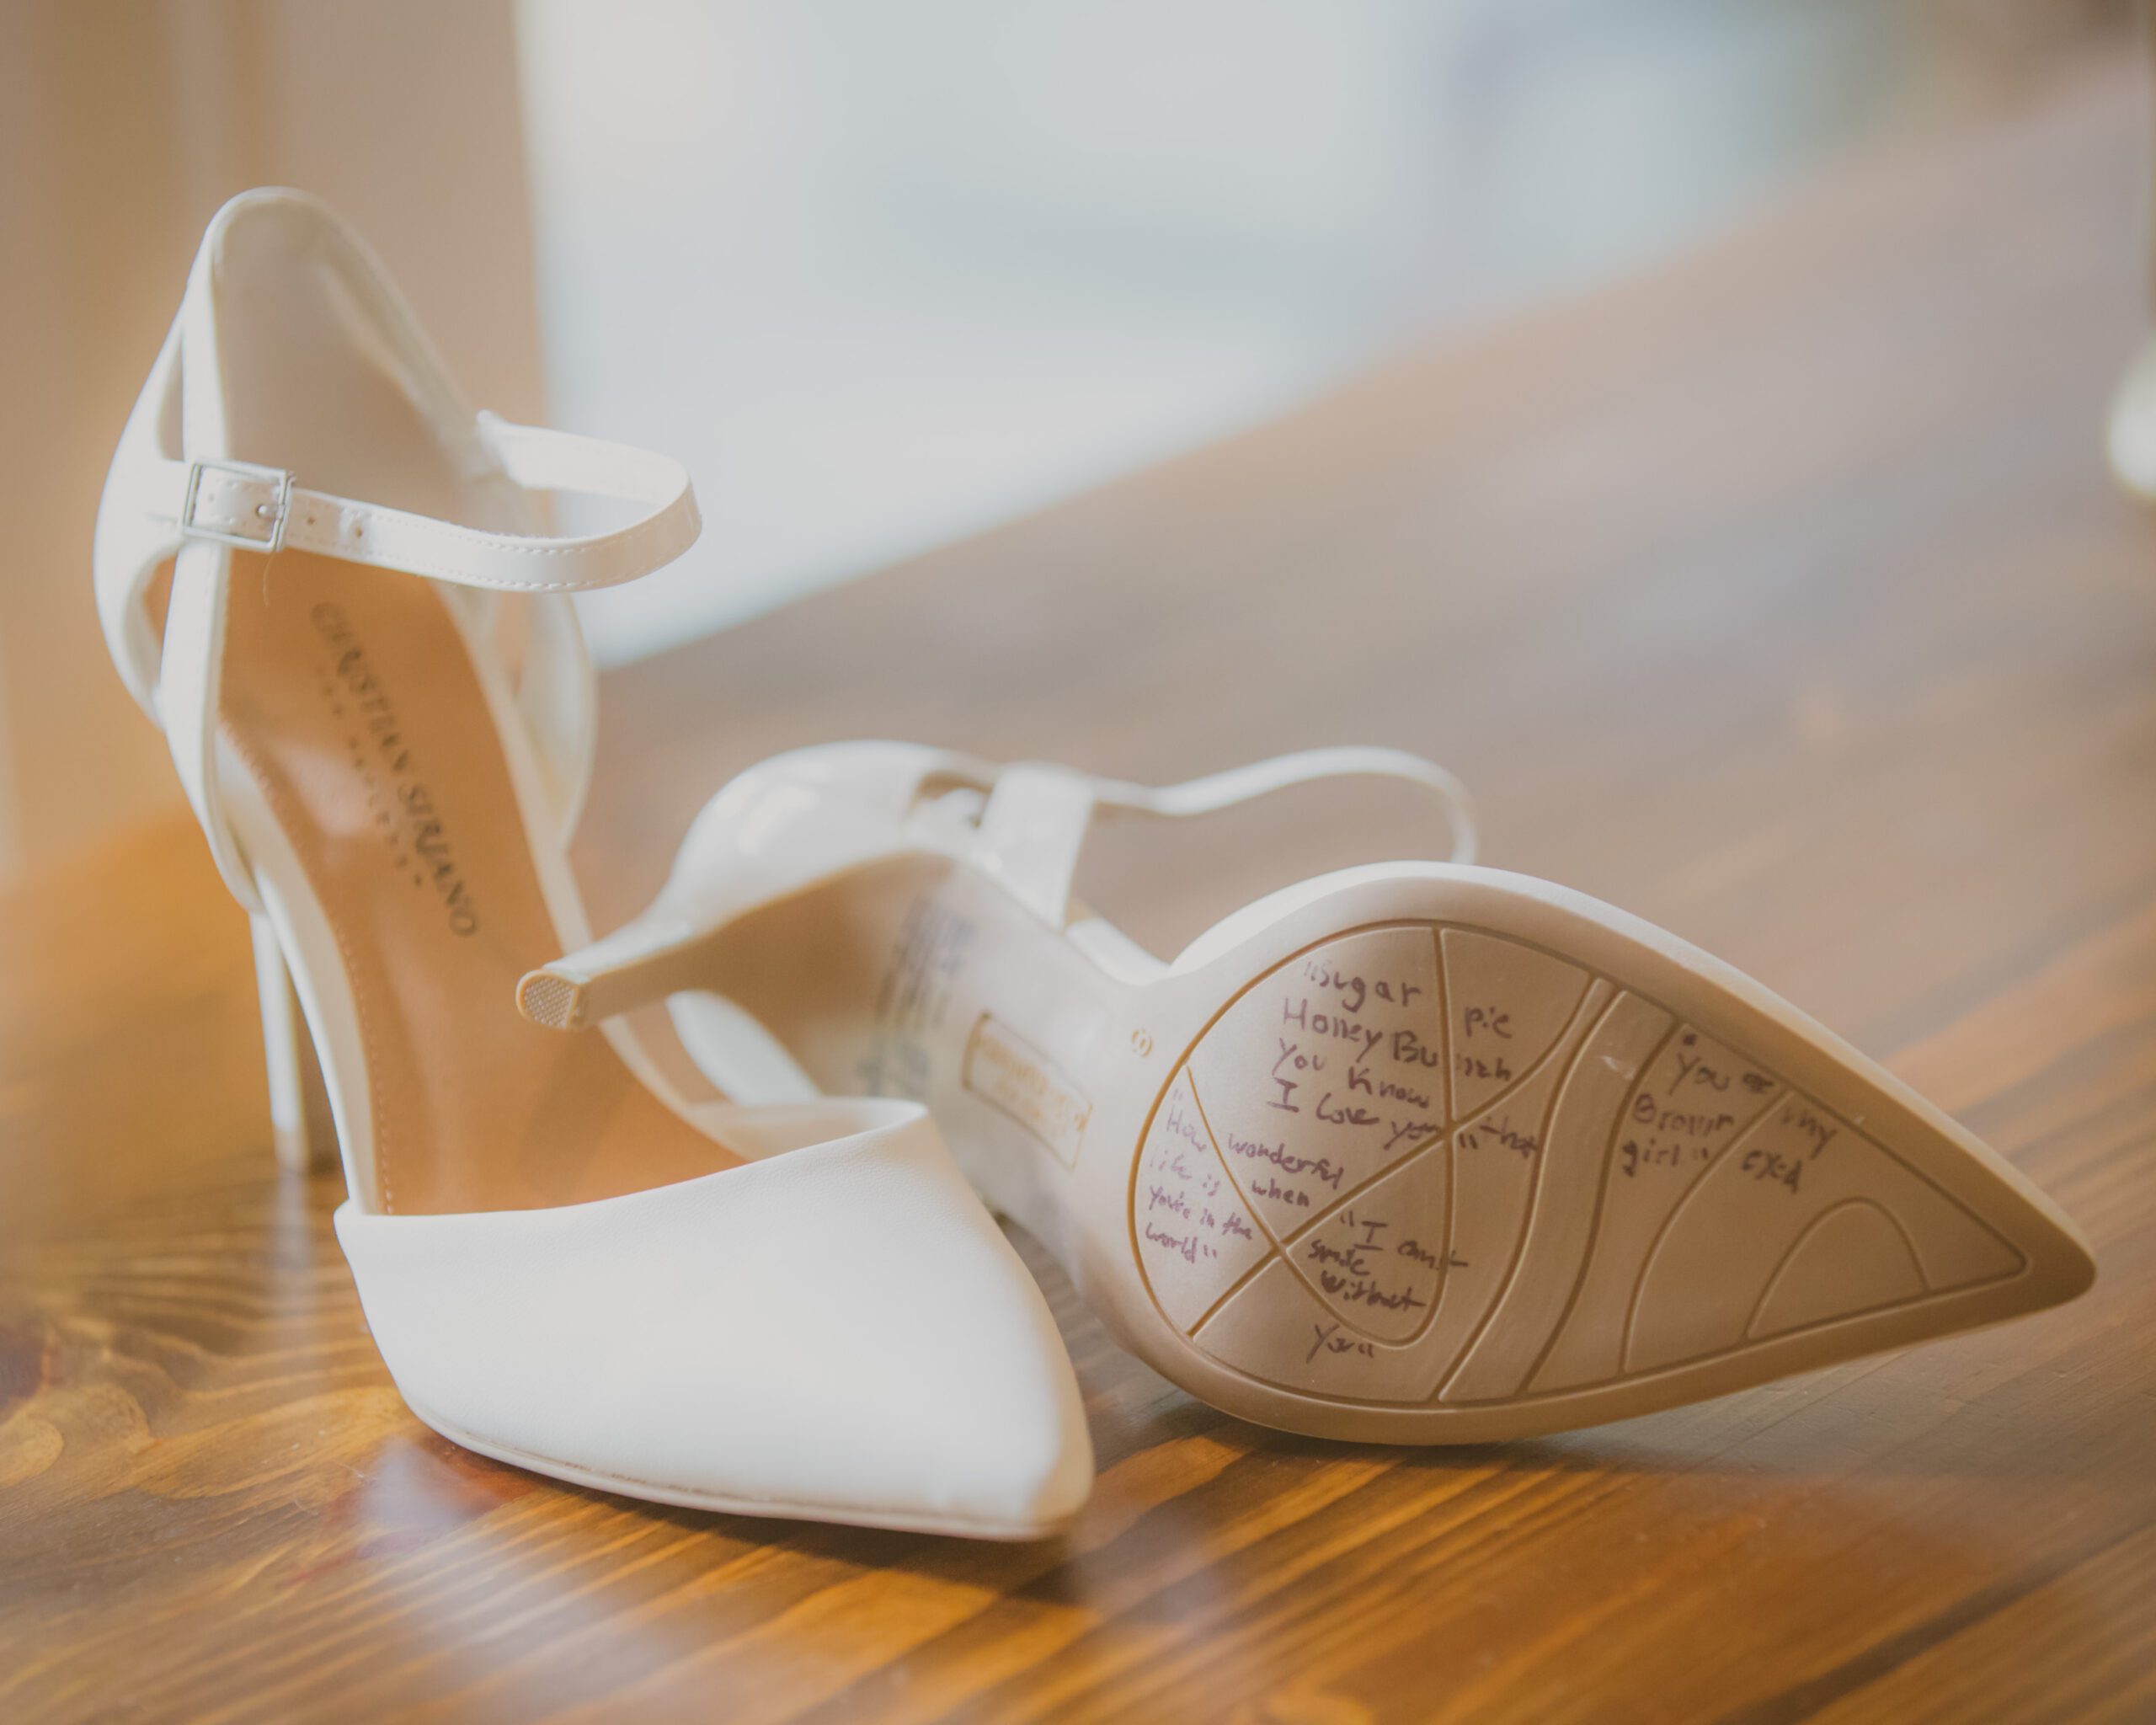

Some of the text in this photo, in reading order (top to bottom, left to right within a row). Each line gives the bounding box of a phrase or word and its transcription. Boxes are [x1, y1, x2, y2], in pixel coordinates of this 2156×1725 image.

[1267, 1077, 1299, 1113] I
[1251, 1177, 1310, 1207] when
[1220, 1211, 1254, 1241] the
